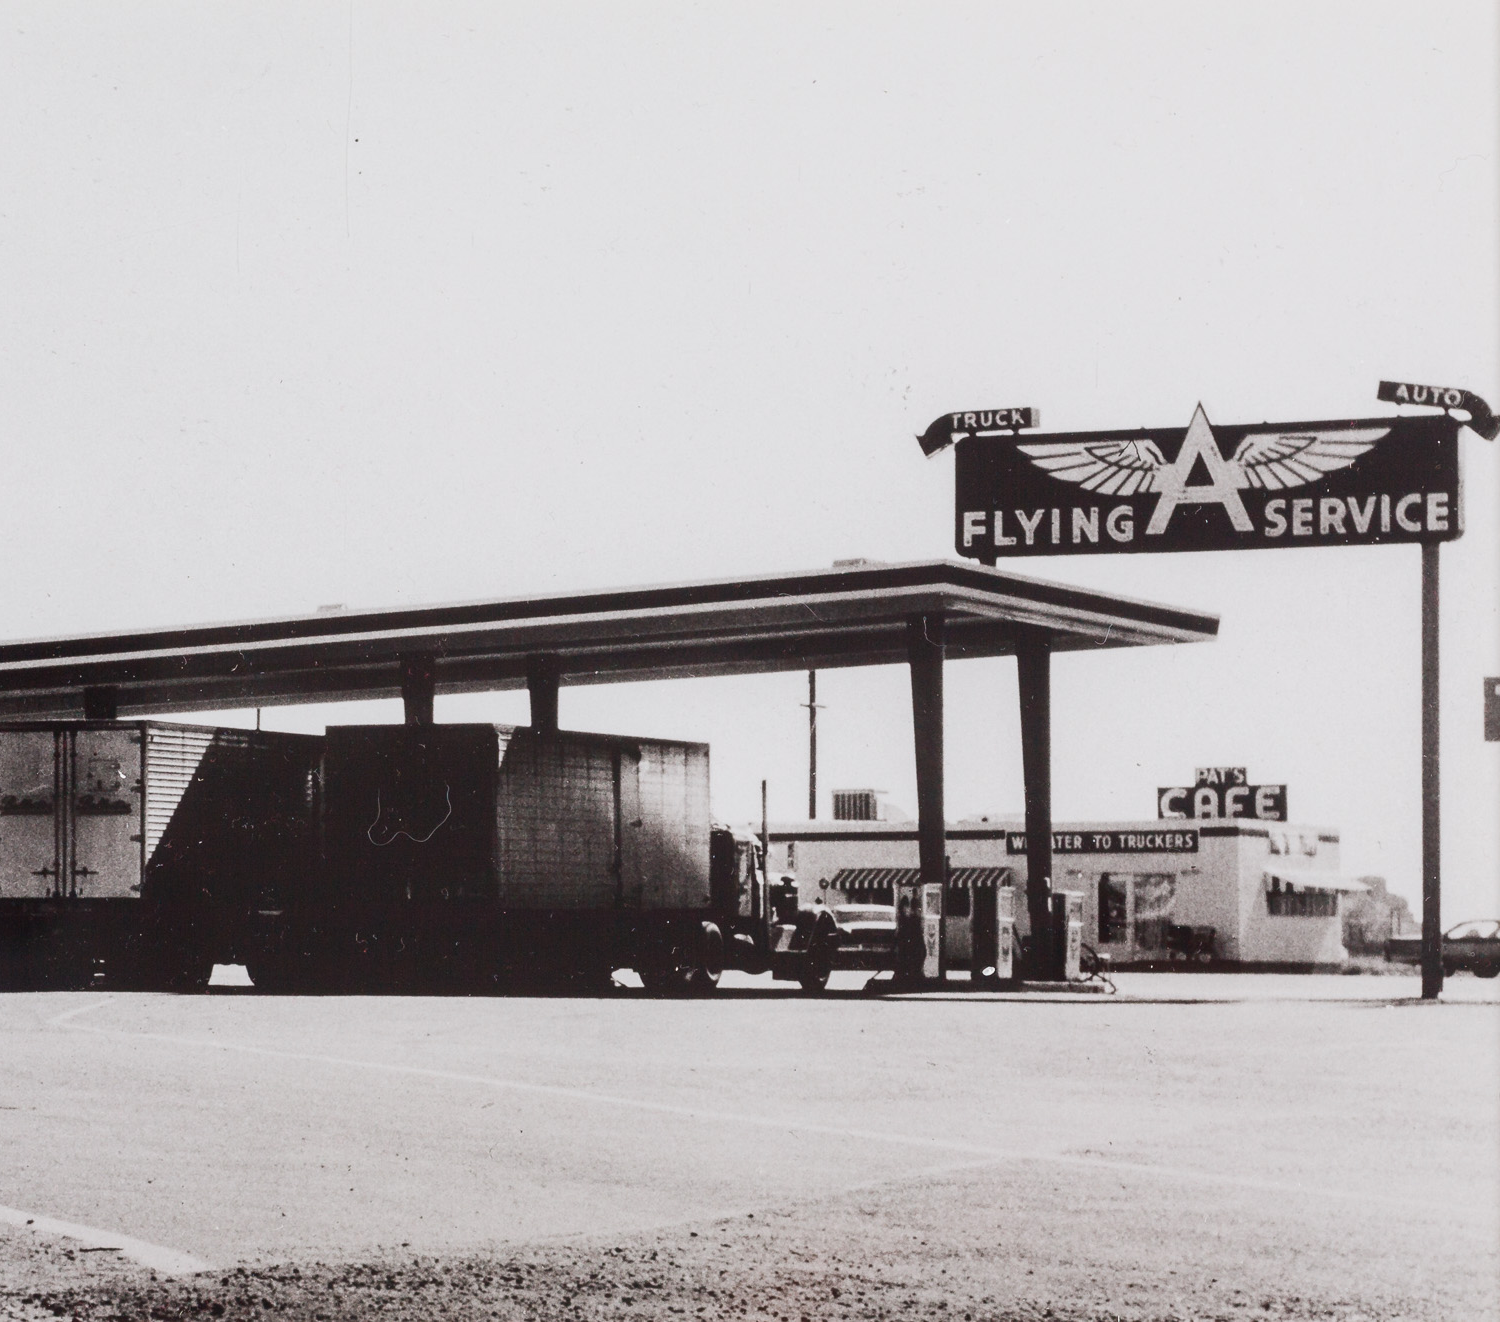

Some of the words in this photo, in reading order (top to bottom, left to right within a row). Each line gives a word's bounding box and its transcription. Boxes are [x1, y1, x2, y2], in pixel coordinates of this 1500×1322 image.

[1396, 383, 1463, 407] AUTO
[952, 408, 1025, 428] TRUCK
[963, 505, 1134, 547] FLYING
[1145, 400, 1255, 535] A
[1264, 492, 1449, 537] SERVICE
[1197, 767, 1245, 785] PAT'S
[1160, 786, 1280, 821] CAFE
[1051, 834, 1082, 850] ATER
[1093, 834, 1112, 850] TO
[1119, 833, 1193, 849] TRUCKERS
